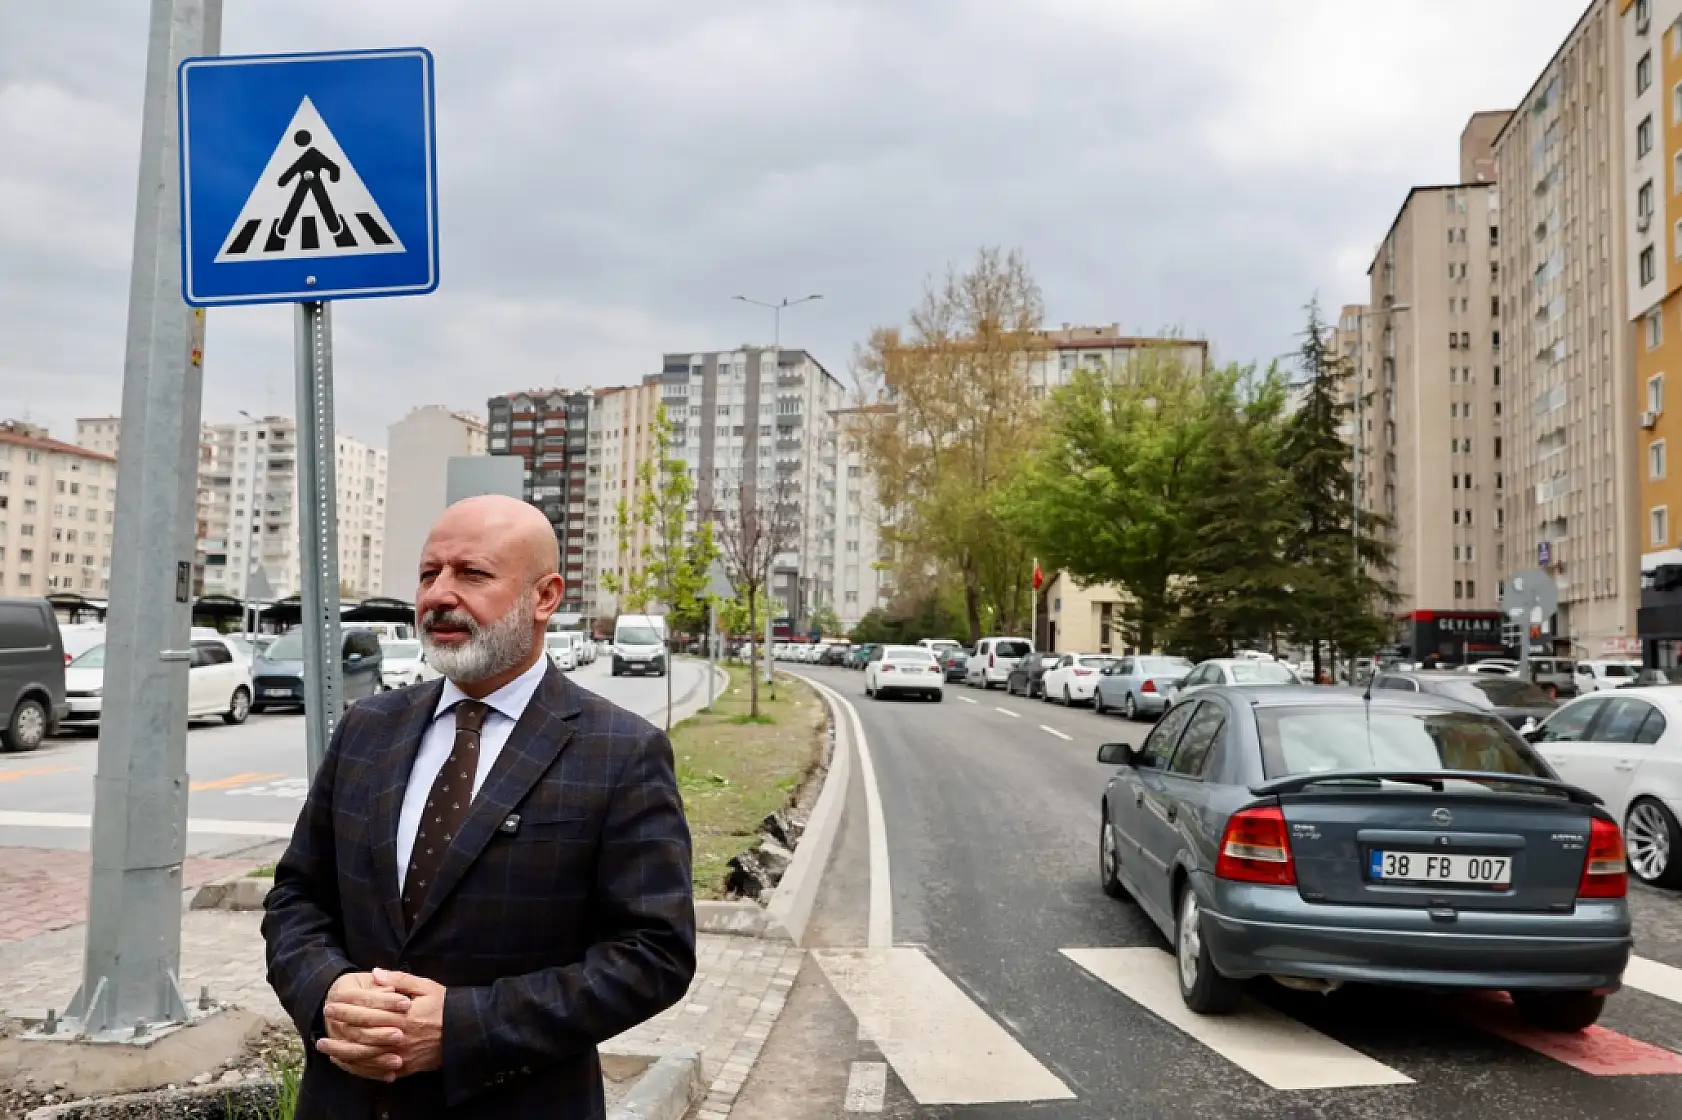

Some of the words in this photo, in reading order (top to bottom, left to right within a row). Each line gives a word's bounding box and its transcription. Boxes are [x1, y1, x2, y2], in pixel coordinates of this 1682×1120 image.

[1385, 853, 1410, 876] 38
[1426, 856, 1451, 878] FB
[1467, 858, 1506, 881] 007
